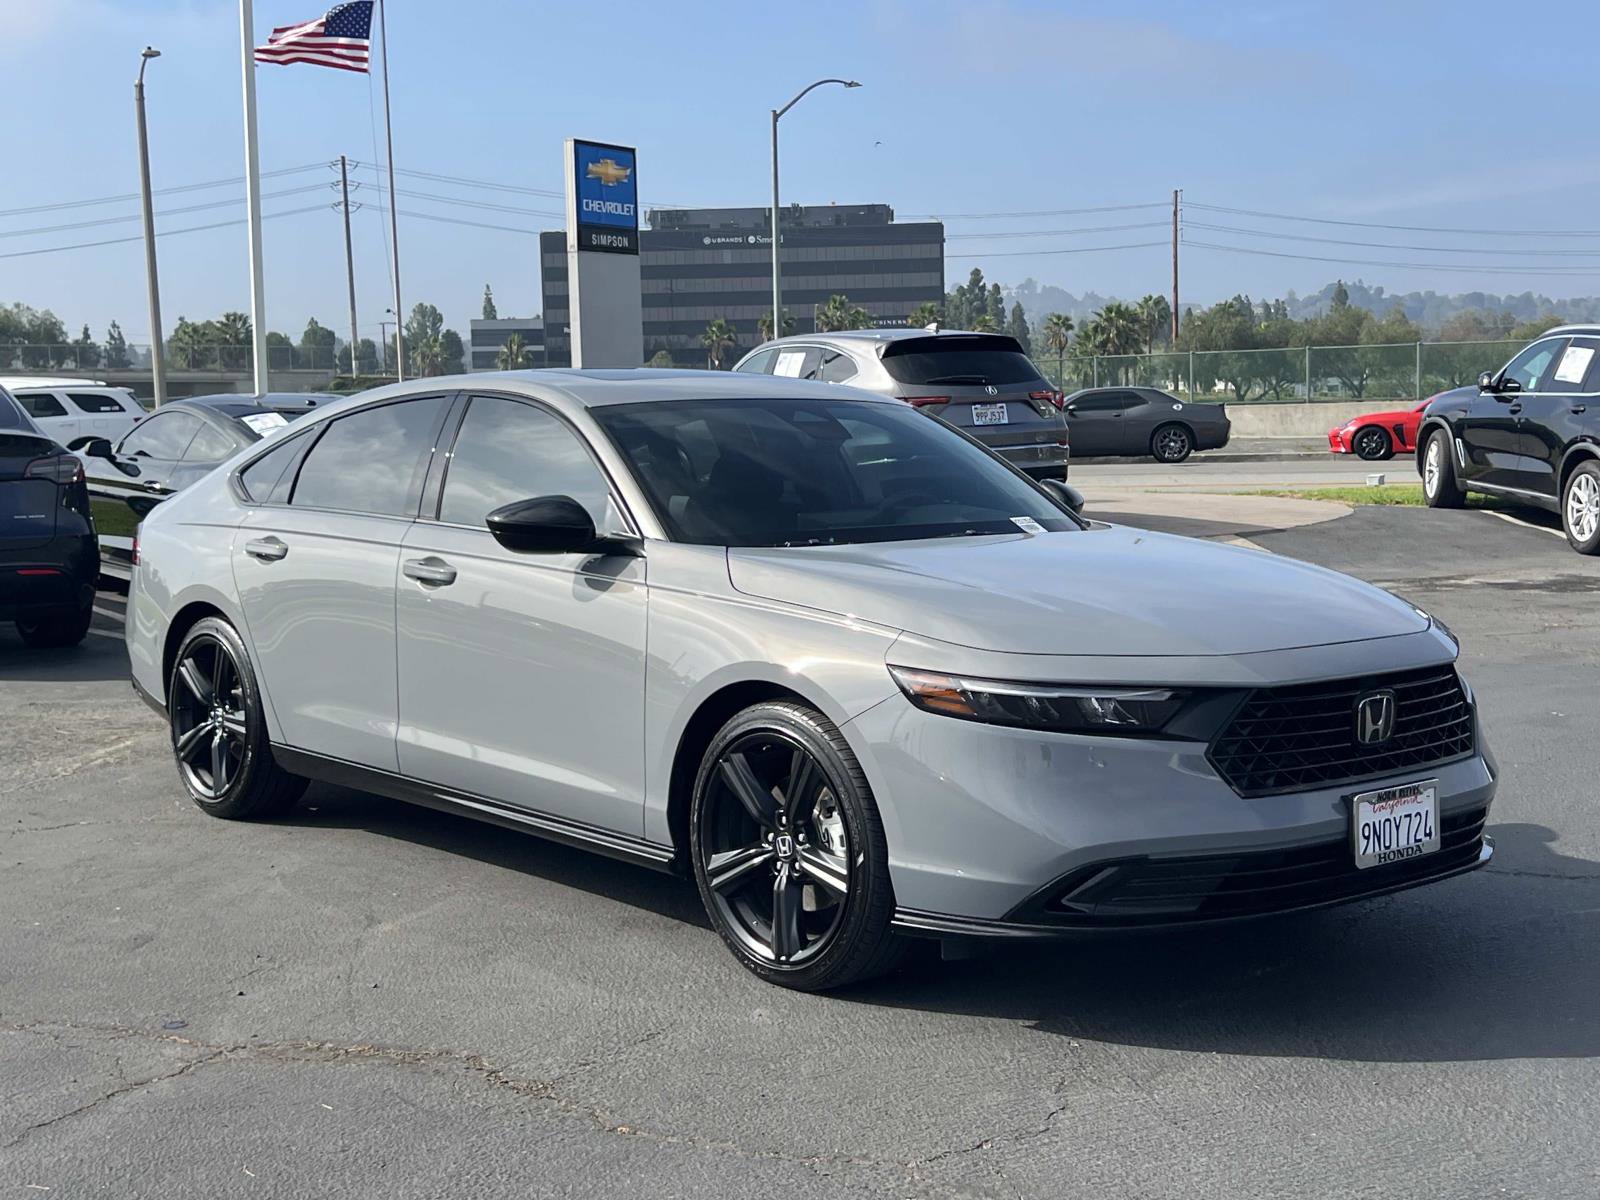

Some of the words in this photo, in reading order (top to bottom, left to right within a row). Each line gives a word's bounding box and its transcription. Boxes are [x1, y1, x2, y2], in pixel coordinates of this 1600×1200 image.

[583, 199, 635, 216] CHEVROLET
[591, 234, 629, 247] SIMPSON
[1378, 844, 1424, 864] HONDA
